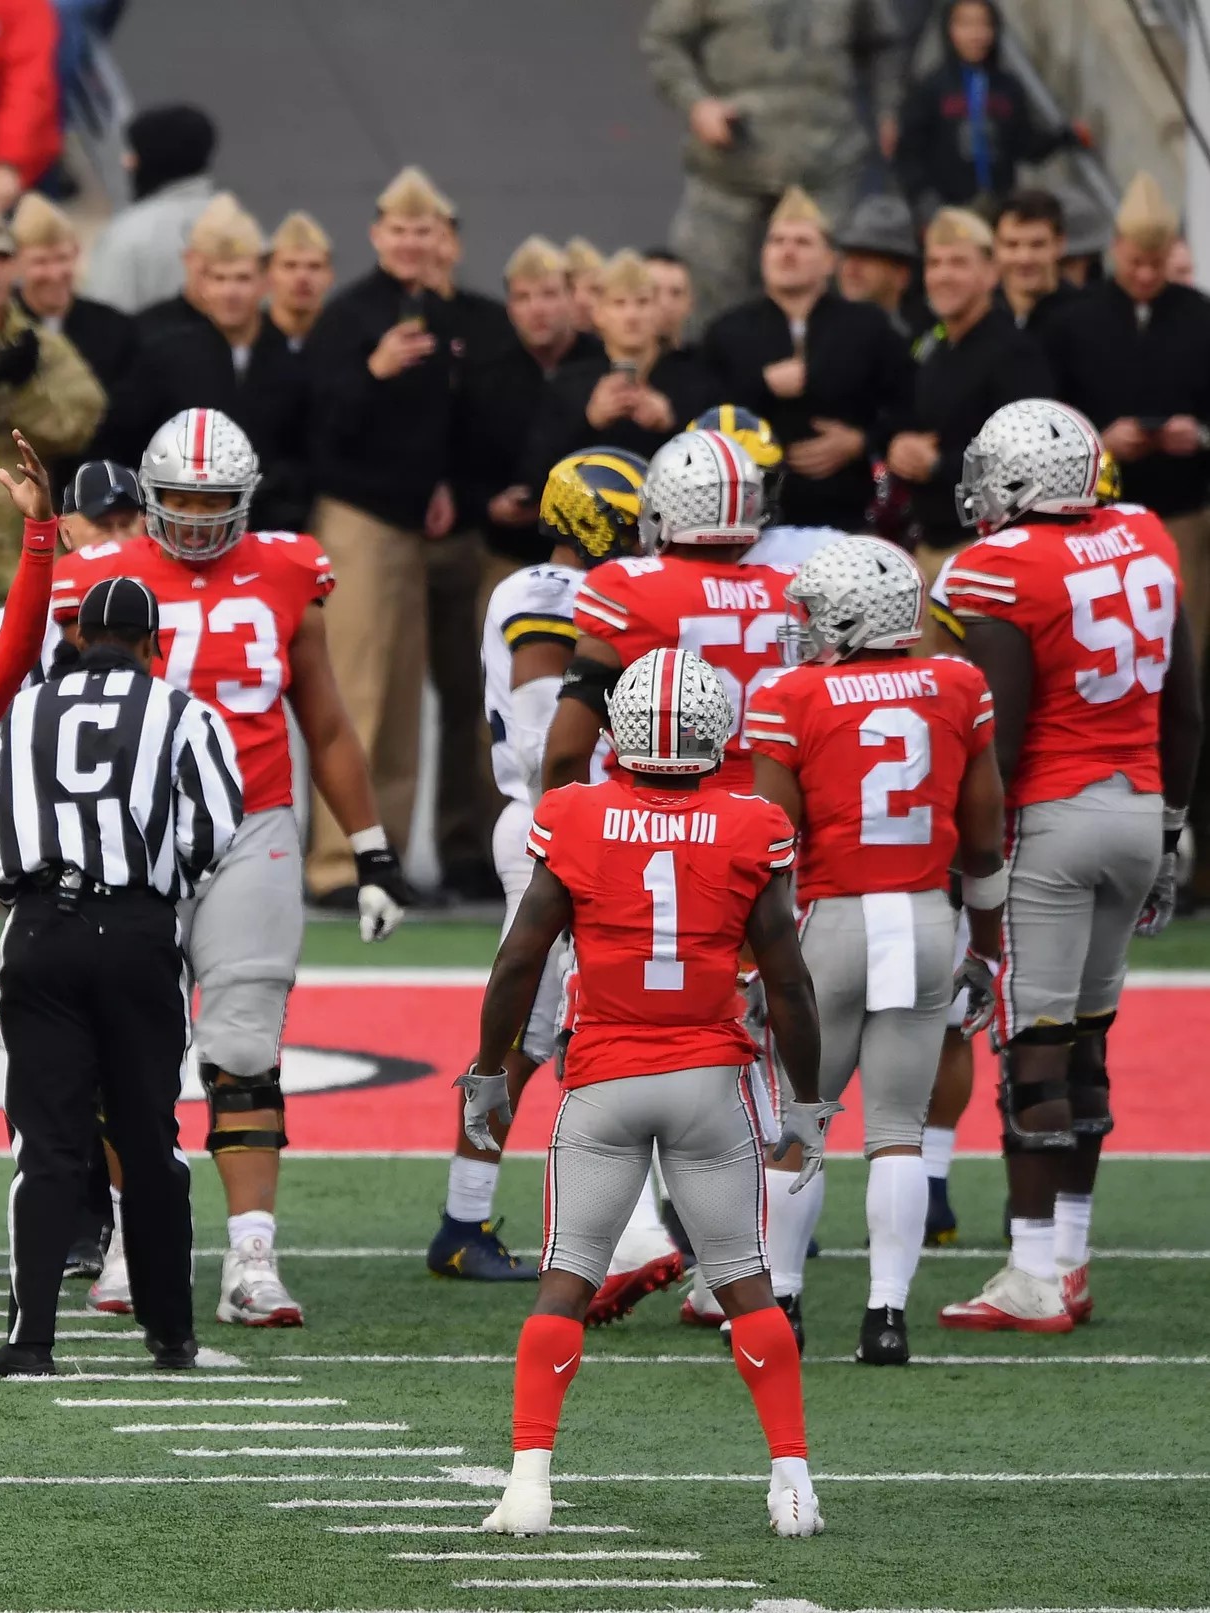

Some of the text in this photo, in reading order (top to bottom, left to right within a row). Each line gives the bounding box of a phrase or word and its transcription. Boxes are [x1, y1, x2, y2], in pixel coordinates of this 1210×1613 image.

[1064, 524, 1145, 565] PRINCE
[701, 577, 771, 610] DAVIS
[158, 597, 282, 714] 73
[1063, 555, 1176, 704] 59
[824, 668, 939, 706] DOBBINS
[56, 703, 121, 794] C
[631, 761, 700, 772] BUCKEYES
[858, 707, 933, 845] 2
[603, 808, 717, 844] DIXON III
[642, 850, 685, 991] 1
